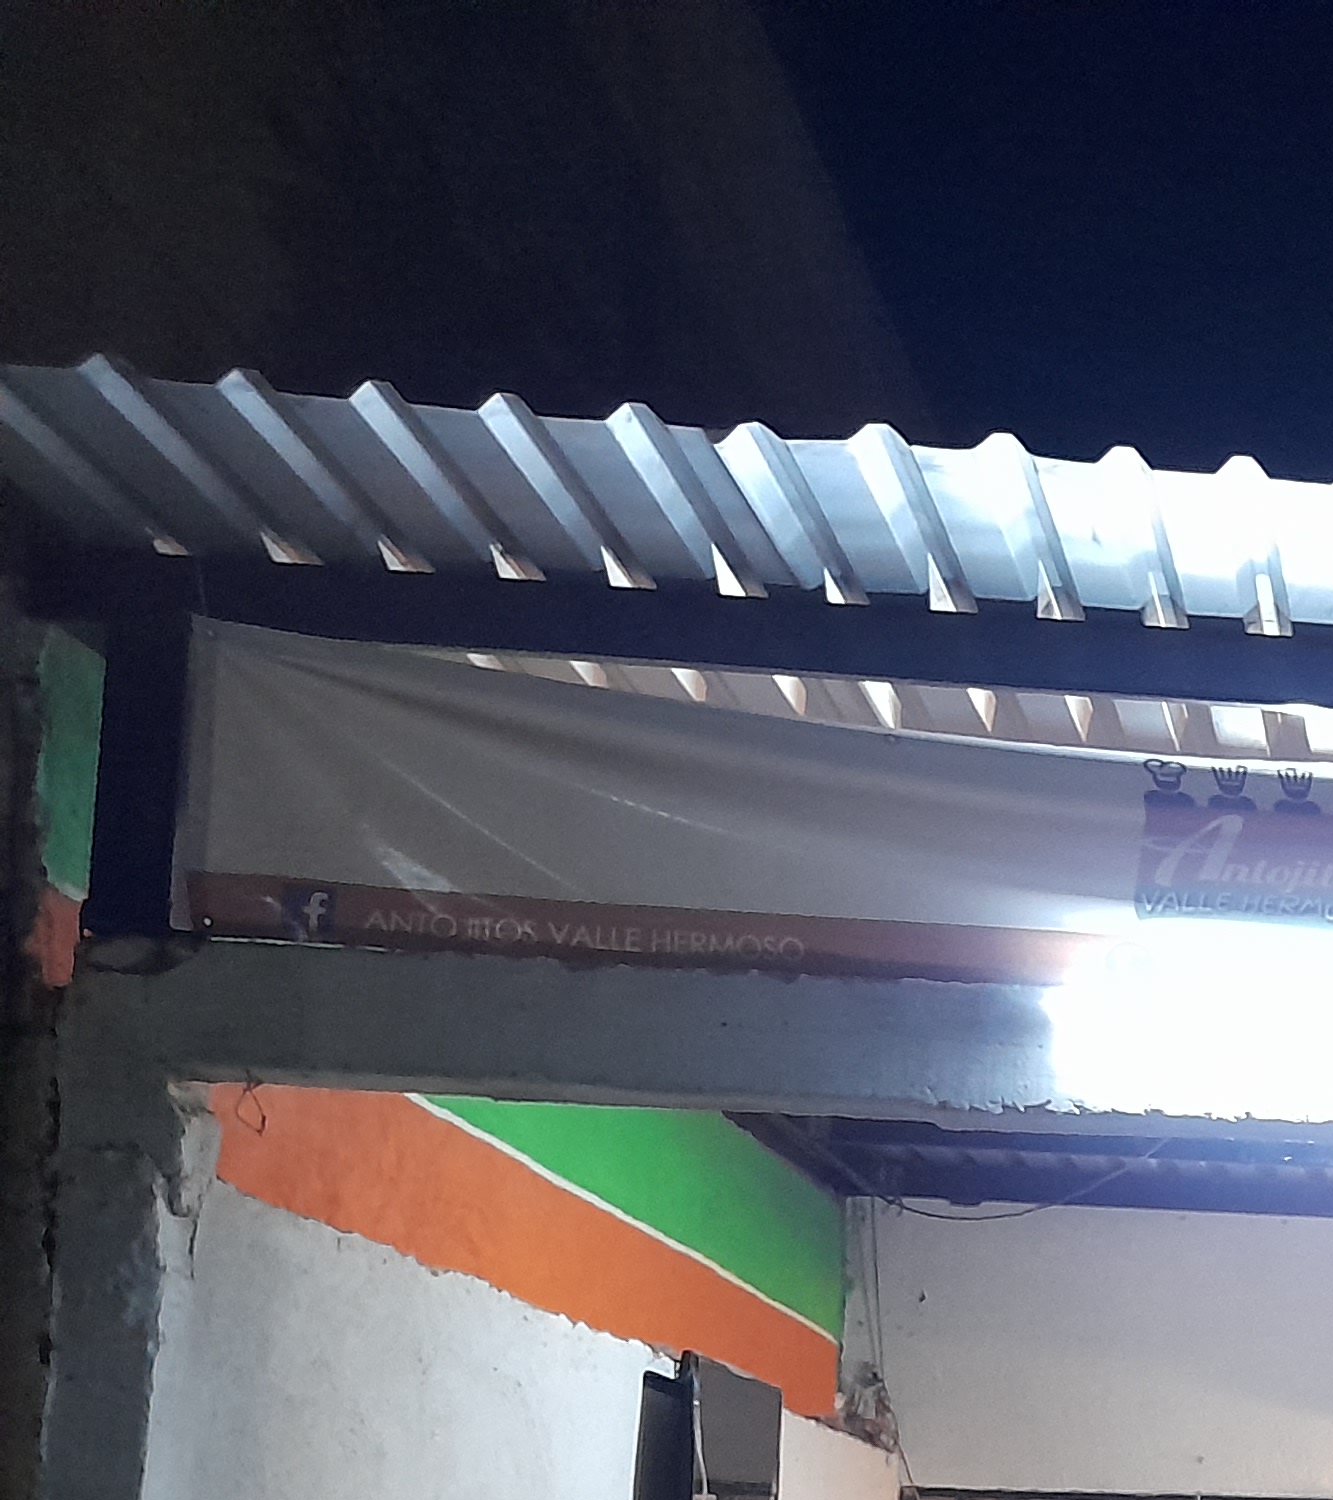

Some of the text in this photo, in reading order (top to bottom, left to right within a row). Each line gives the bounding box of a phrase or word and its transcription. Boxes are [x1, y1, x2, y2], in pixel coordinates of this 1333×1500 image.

[1141, 892, 1231, 914] VALLE
[548, 921, 643, 952] VALLE
[651, 930, 804, 962] HERMOSO
